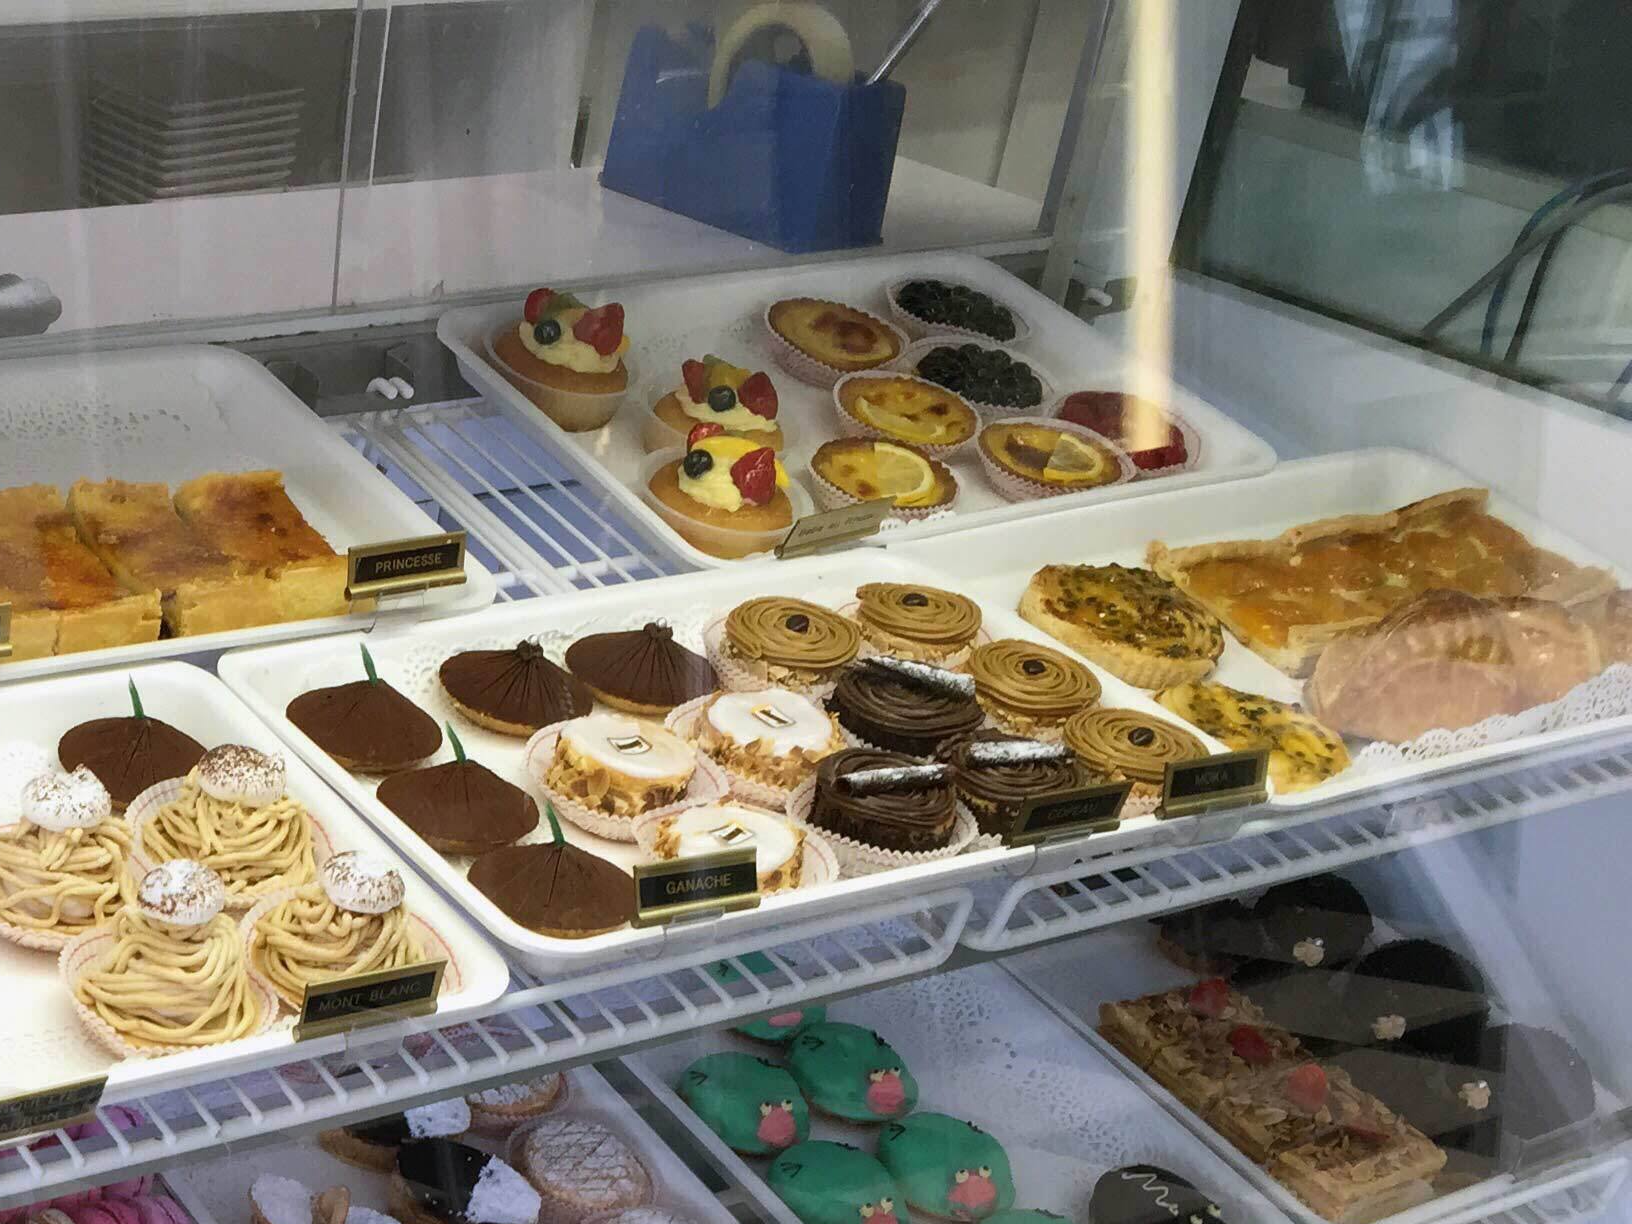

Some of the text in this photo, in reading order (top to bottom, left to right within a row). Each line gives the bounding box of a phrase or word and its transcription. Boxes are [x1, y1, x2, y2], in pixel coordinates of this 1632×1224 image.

[375, 552, 443, 573] PRINCESSE
[665, 873, 732, 895] GANACHE
[318, 982, 420, 1012] MONT BLANC
